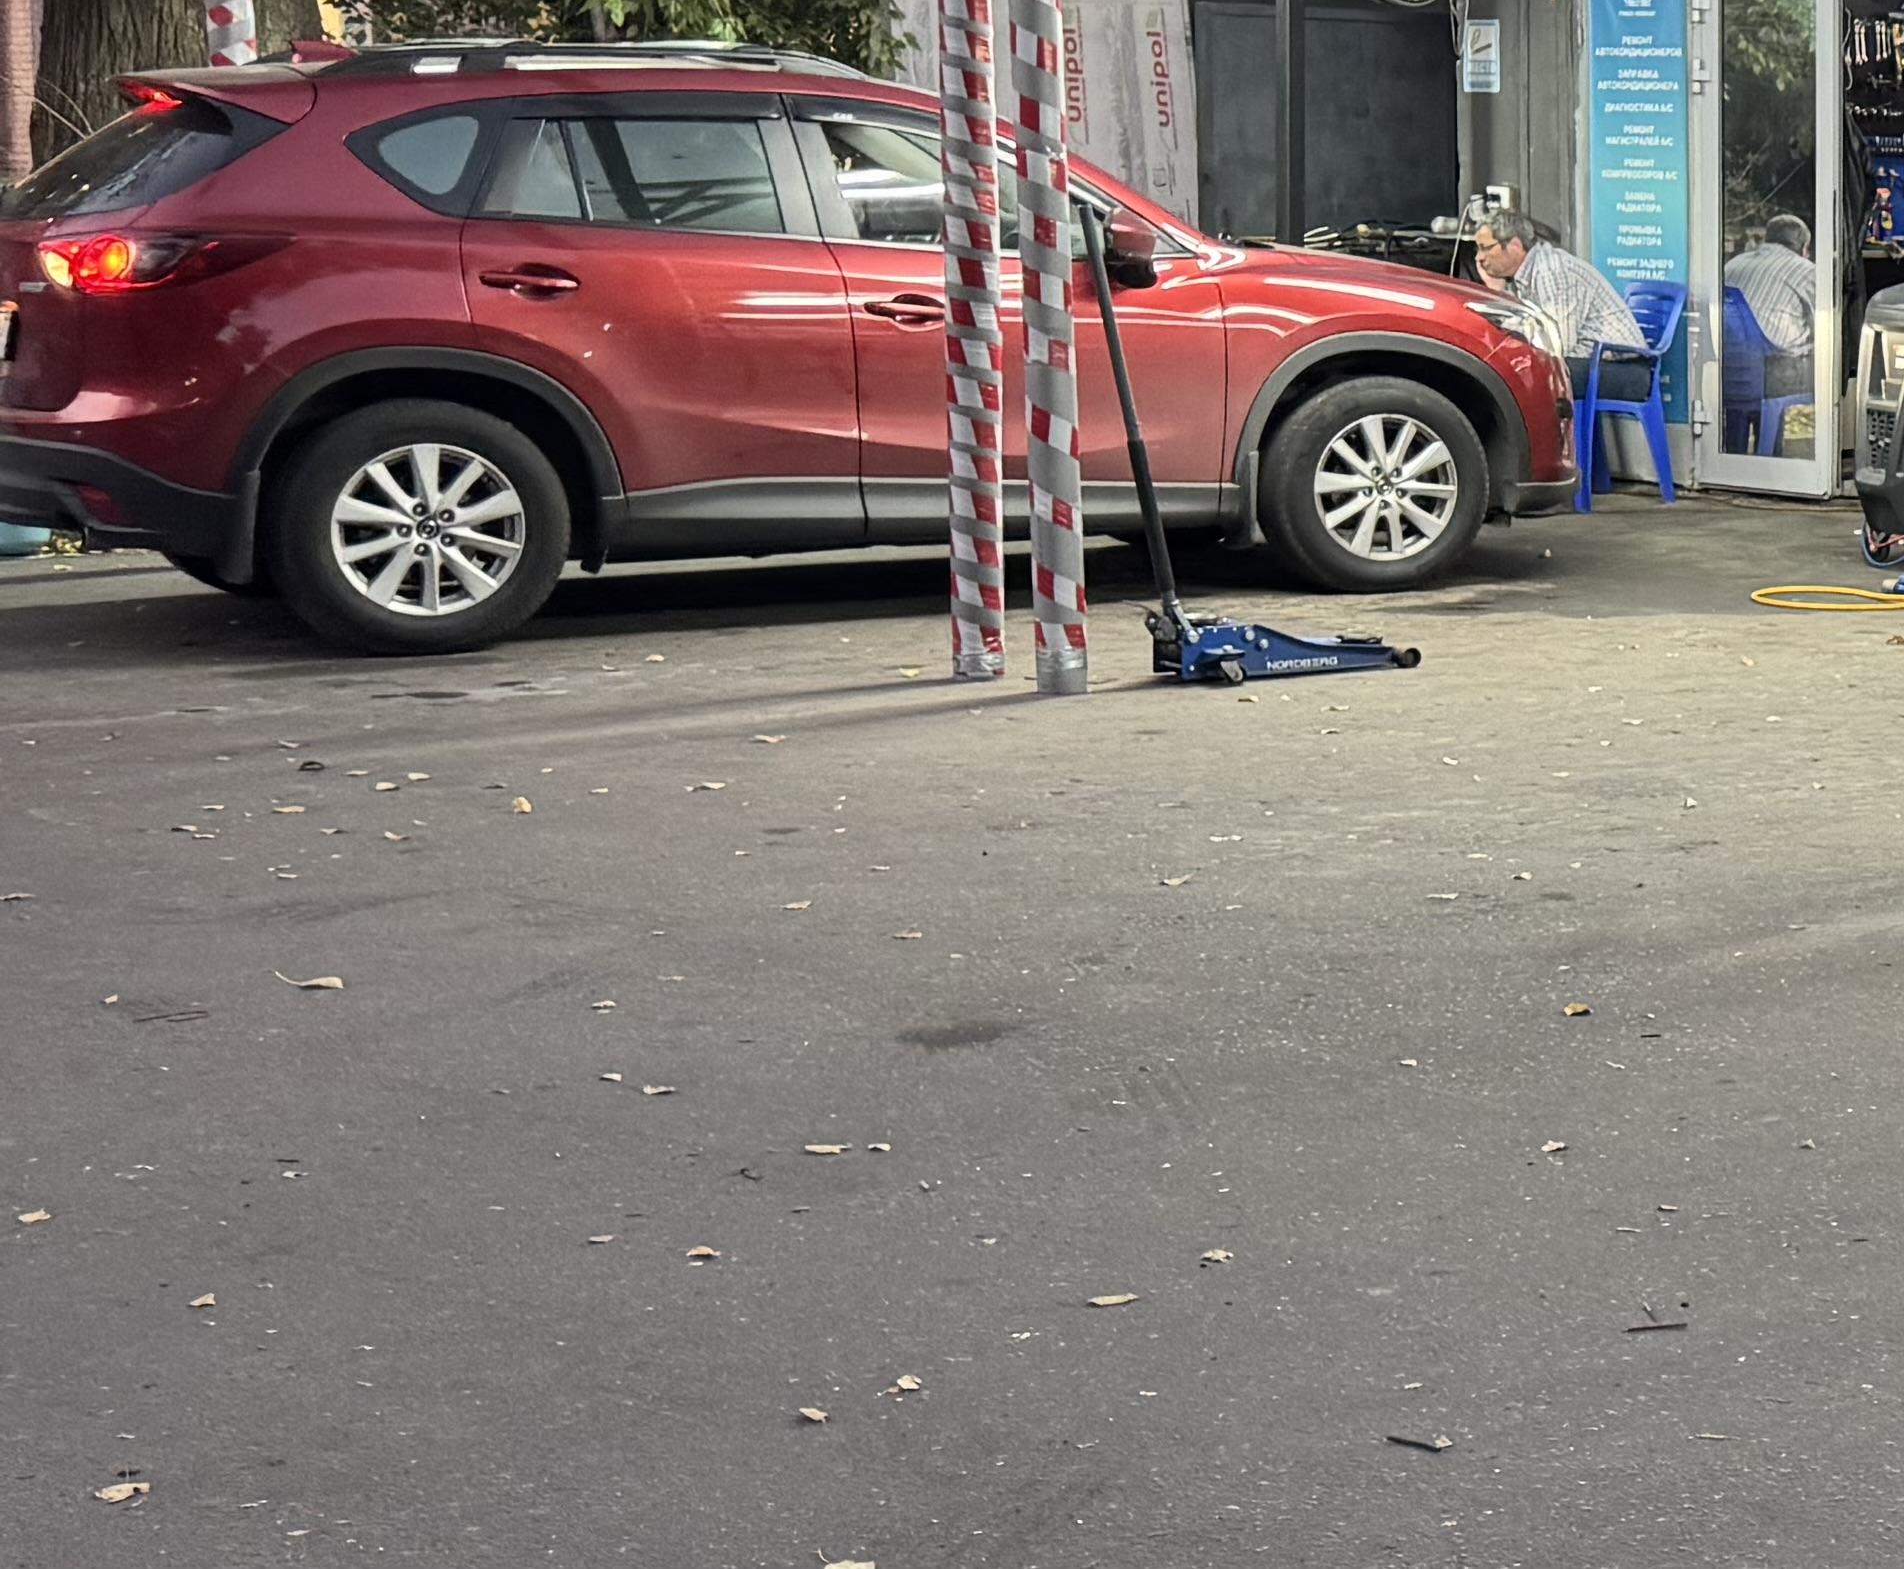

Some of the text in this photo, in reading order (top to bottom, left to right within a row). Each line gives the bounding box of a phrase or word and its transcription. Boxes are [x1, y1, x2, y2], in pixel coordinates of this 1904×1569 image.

[1063, 28, 1082, 123] unipol
[1147, 30, 1171, 128] unipol
[1266, 656, 1338, 671] NORDBERG
